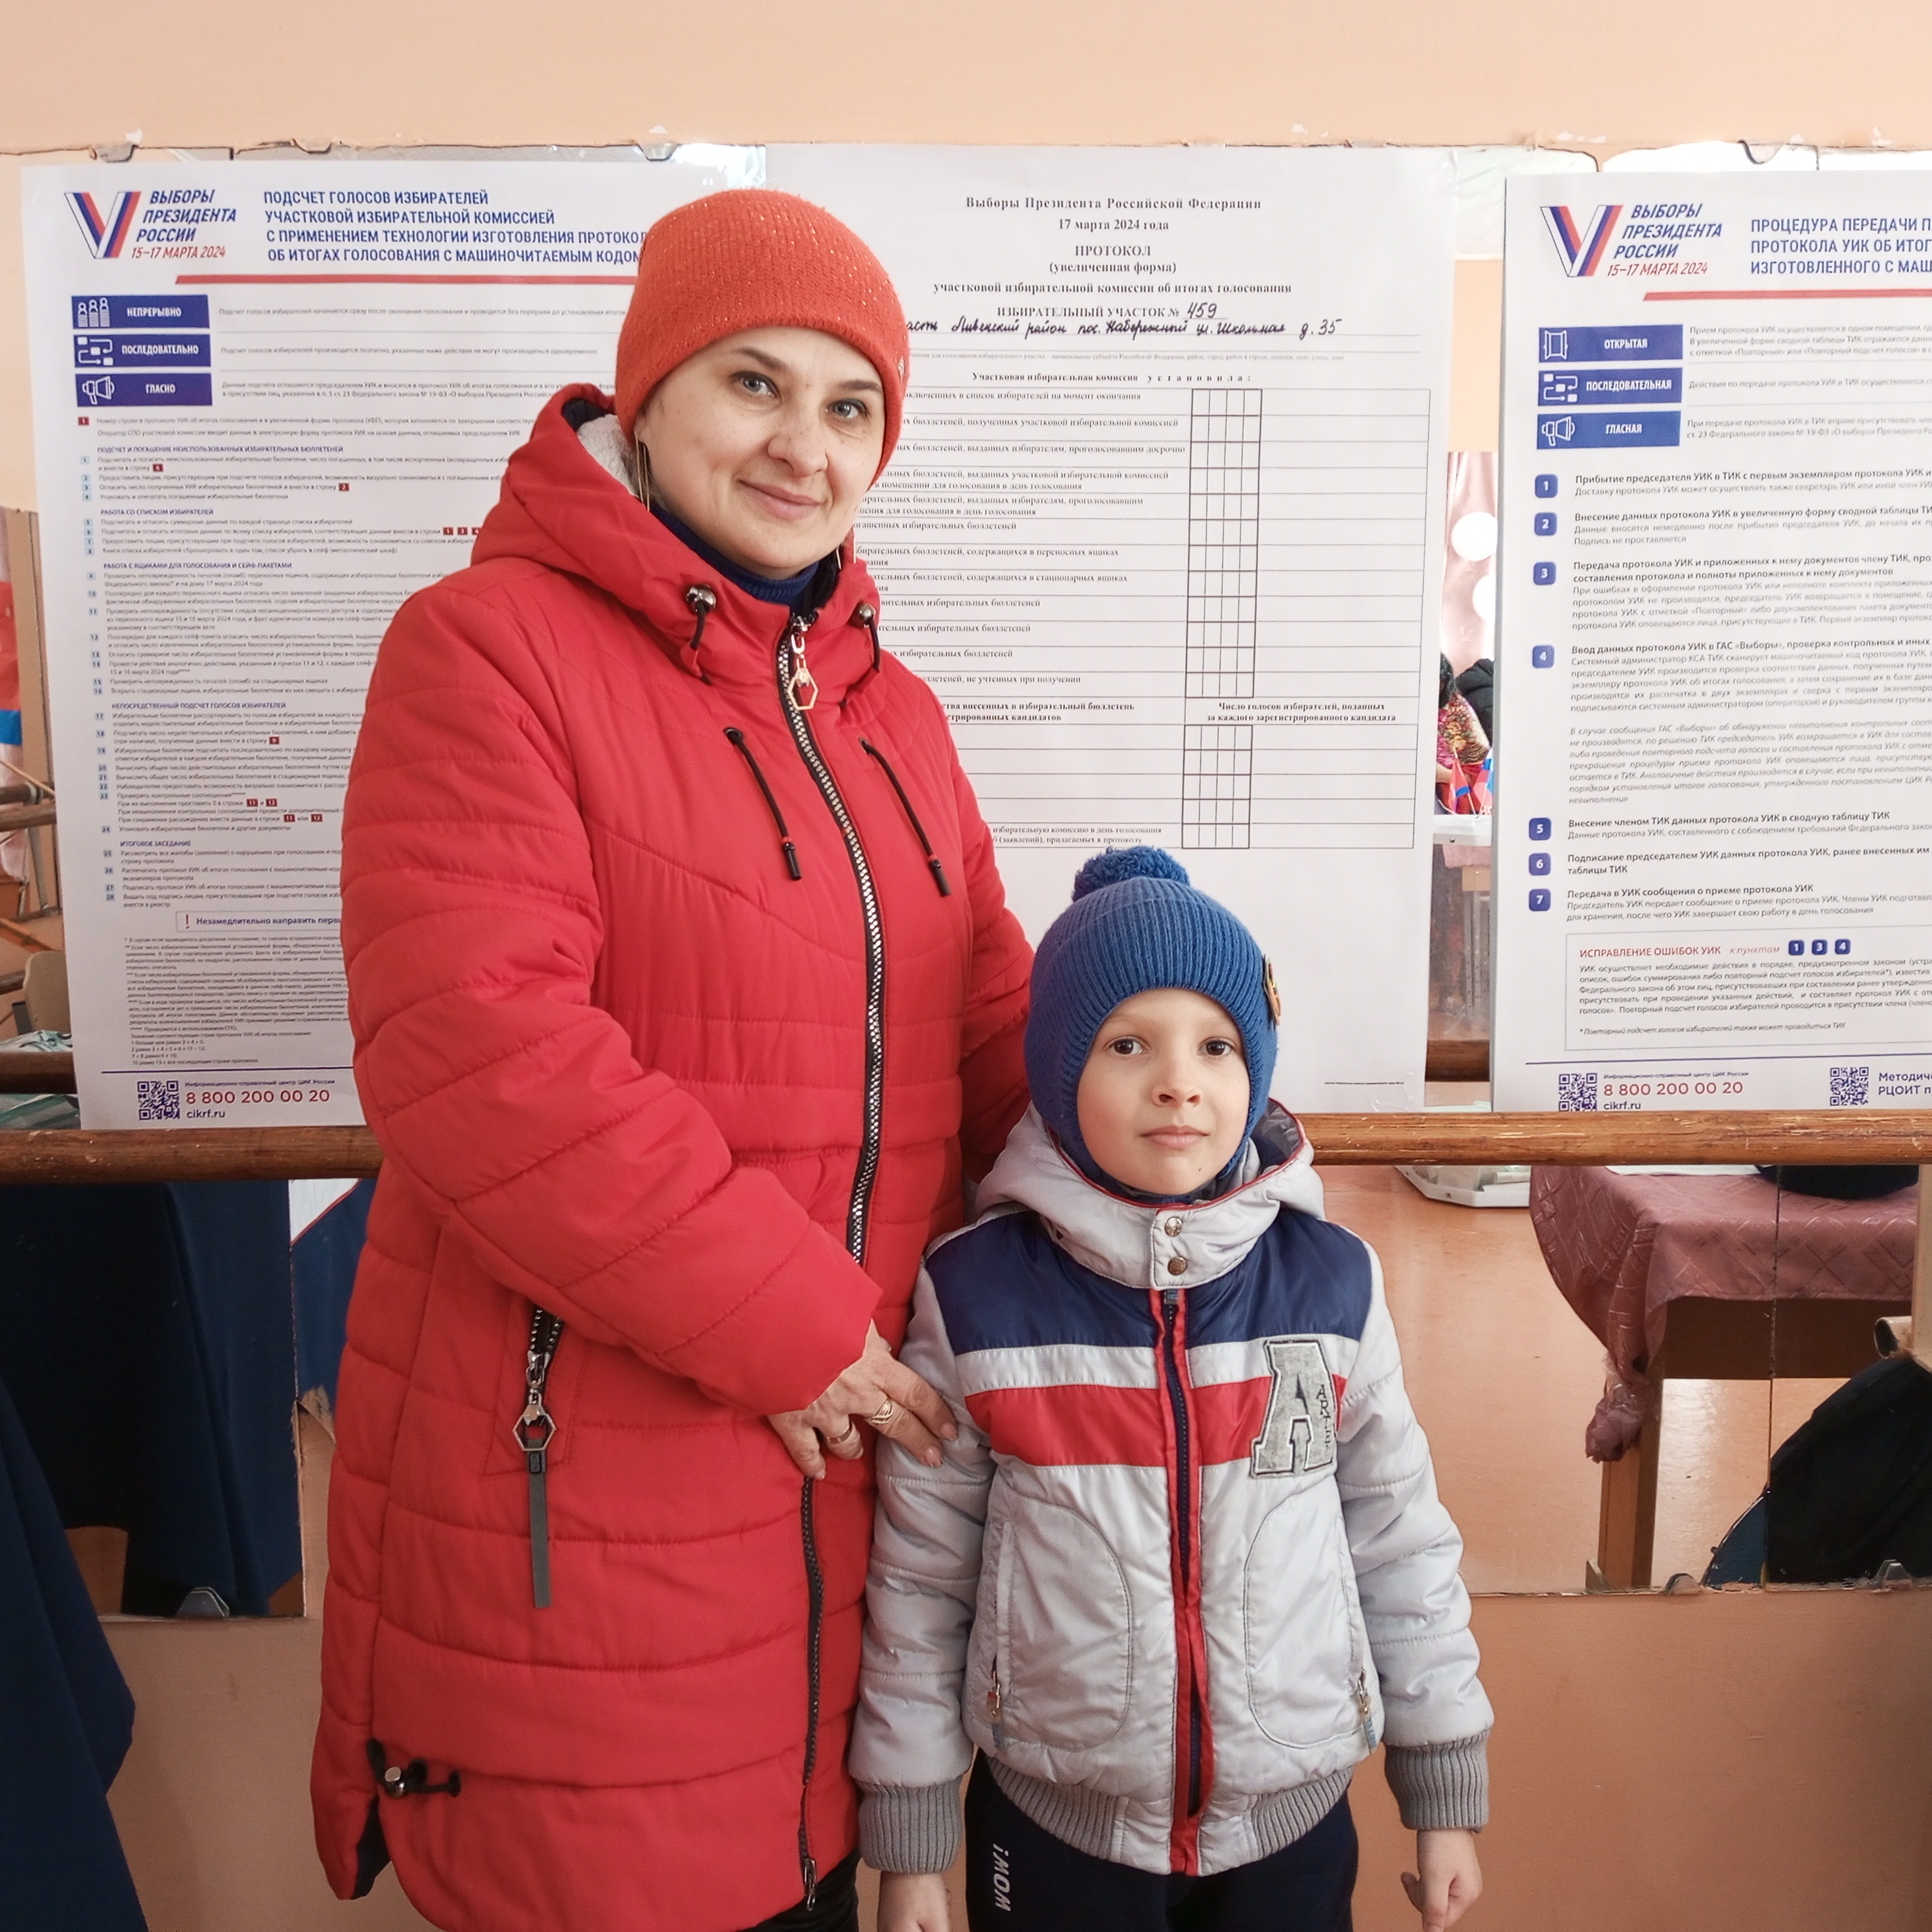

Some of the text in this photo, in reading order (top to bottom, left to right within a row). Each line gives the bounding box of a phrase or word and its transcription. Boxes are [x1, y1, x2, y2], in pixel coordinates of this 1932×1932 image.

[150, 190, 215, 204] ВЫБОРЫ
[264, 189, 488, 206] ПОДСЧЕТ ГОЛОСОВ ИЗБИРАТЕЛЕЙ
[967, 198, 1260, 211] Выборы Президента Российской Федерации
[143, 208, 236, 224] ПРЕЗИДЕНТА
[265, 208, 554, 224] УЧАСТКОВОЙ ИЗБИРАТЕЛЬНОЙ КОМИССИЕЙ
[1631, 203, 1702, 219] ВЫБОРЫ
[1060, 219, 1169, 232] 17 марта 2024 года
[1752, 219, 1838, 234] ПРОЦЕДУРА
[1843, 218, 1917, 234] ПЕРЕДАЧИ
[136, 228, 196, 242] РОССИИ
[267, 230, 646, 243] С ПРИМЕНЕНИЕМ ТЕХНОЛОГИИ ИЗГОТОВЛЕНИЯ ПРОТОКОЛ
[1622, 223, 1722, 240] ПРЕЗИДЕНТА
[1076, 245, 1150, 256] ПРОТОКОЛ
[1614, 244, 1679, 259] РОССИИ
[1752, 239, 1932, 253] ПРОТОКОЛА УИК ОБ ИТОГ
[163, 246, 198, 259] МАРТА
[200, 245, 225, 258] 2024
[268, 249, 285, 261] ОБ
[289, 249, 339, 261] ИТОГАХ
[344, 249, 439, 261] ГОЛОСОВАНИЯ
[444, 250, 452, 261] С
[456, 249, 592, 262] МАШИНОЧИТАЕМЫМ
[1050, 262, 1176, 275] (увеличенная форма)
[1640, 263, 1679, 275] МАРТА
[1681, 262, 1707, 274] 2024
[1752, 261, 1880, 274] ИЗГОТОВЛЕННОГО
[1885, 261, 1893, 272] С
[934, 283, 1001, 294] участковой
[1006, 282, 1093, 295] избирательной
[1158, 284, 1170, 292] об
[127, 307, 181, 317] НЕПРЕРЫВНО
[998, 306, 1179, 319] ИЗБИРАТЕЛЬНЫЙ УЧАСТОК №
[1187, 302, 1219, 320] 459
[908, 320, 938, 331] асть
[1024, 320, 1067, 339] район
[1078, 324, 1101, 334] пос.
[1106, 320, 1188, 341] Набережный
[1217, 322, 1286, 335] Школьная
[1299, 323, 1314, 339] д.
[1318, 319, 1343, 335] 35
[1605, 339, 1647, 349] ОТКРЫТАЯ
[122, 345, 198, 355] ПОСЛЕДОВАТЕЛЬНО
[973, 373, 1024, 383] Участковая
[1028, 373, 1093, 382] избирательная
[146, 384, 175, 393] ГЛАСНО
[1586, 379, 1671, 392] ПОСЛЕДОВАТЕЛЬНАЯ
[913, 417, 965, 426] бюллетеней,
[1021, 418, 1067, 428] участковой
[1070, 418, 1132, 428] избирательной
[1606, 424, 1642, 434] ГЛАСНАЯ
[1576, 474, 1624, 486] Прибытие
[1627, 475, 1691, 484] председателя
[1694, 472, 1712, 481] УИК
[1544, 481, 1548, 490] 1
[1542, 519, 1549, 529] 2
[1574, 537, 1610, 546] Подпись
[1625, 537, 1686, 545] проставляется
[1541, 568, 1547, 578] 3
[1540, 652, 1547, 661] 4
[1283, 702, 1339, 712] избирателей,
[1536, 824, 1543, 833] 5
[1536, 859, 1543, 868] 6
[1568, 891, 1611, 899] Передача
[1643, 887, 1695, 896] сообщения
[1744, 887, 1792, 895] протокола
[1536, 895, 1544, 904] 7
[318, 918, 341, 927] перв
[1580, 946, 1721, 957] ИСПРАВЛЕНИЕ ОШИБОК УИК
[1737, 947, 1780, 956] пунктам
[1794, 943, 1799, 952] 1
[1816, 942, 1822, 952] 3
[1839, 942, 1847, 950] 4
[1879, 1073, 1932, 1082] Методич
[1604, 1082, 1742, 1096] 8 800 200 00 20
[1879, 1085, 1920, 1096] РЦОИТ
[186, 1089, 329, 1104] 8 800 200 00 20
[1604, 1102, 1641, 1112] cikrf.ru
[187, 1109, 225, 1118] cikrf.ru
